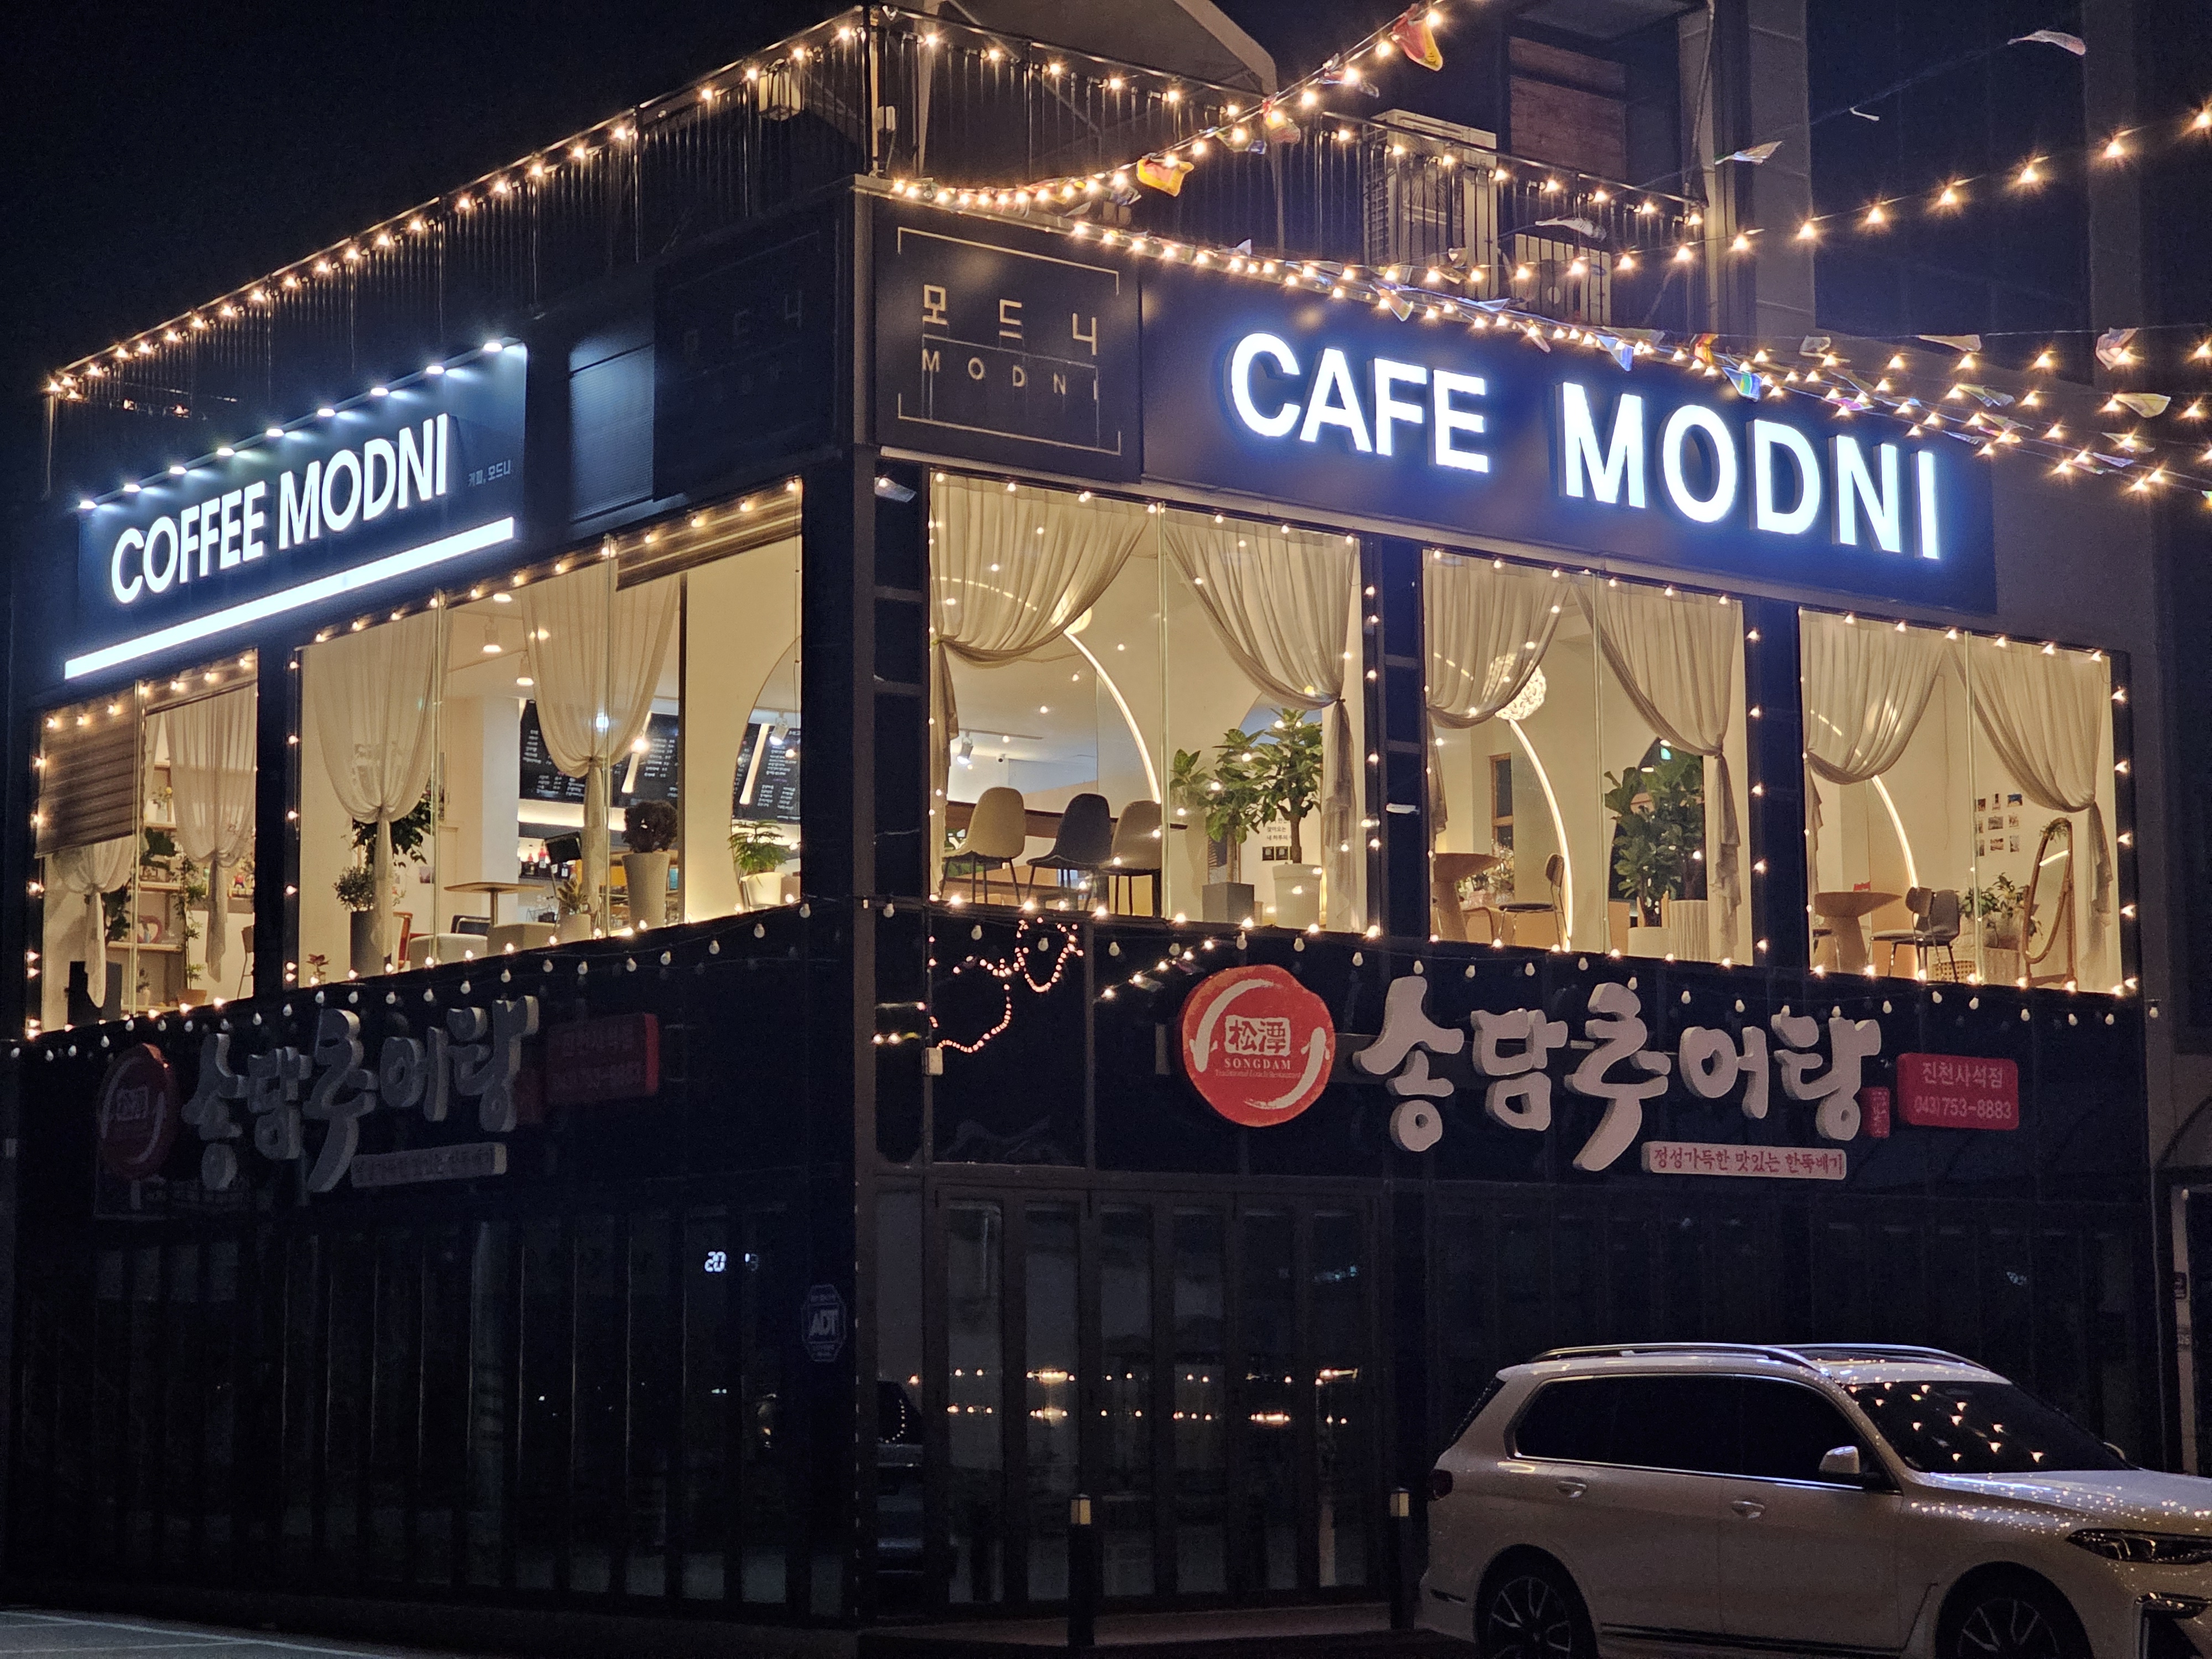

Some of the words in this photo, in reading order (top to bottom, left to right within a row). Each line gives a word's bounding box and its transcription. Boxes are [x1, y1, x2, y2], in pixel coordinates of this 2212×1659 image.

[922, 284, 1097, 356] 모드니
[922, 348, 1098, 400] MODNI
[1229, 332, 1490, 473] CAFE
[1558, 382, 1940, 559] MODNI
[488, 459, 511, 481] 모드니
[111, 480, 266, 604] COFFEE
[278, 413, 448, 550] MODNI
[1228, 1020, 1286, 1053] 松潭
[1224, 1057, 1291, 1070] SONGDAM
[1352, 975, 1882, 1172] 송담추어탕
[1922, 1061, 2003, 1089] 진천사석점
[1655, 1146, 1729, 1171] 정성가득한
[1735, 1148, 1780, 1172] 맛있는
[1786, 1152, 1843, 1175] 한뚝배기
[808, 1309, 839, 1336] ADT
